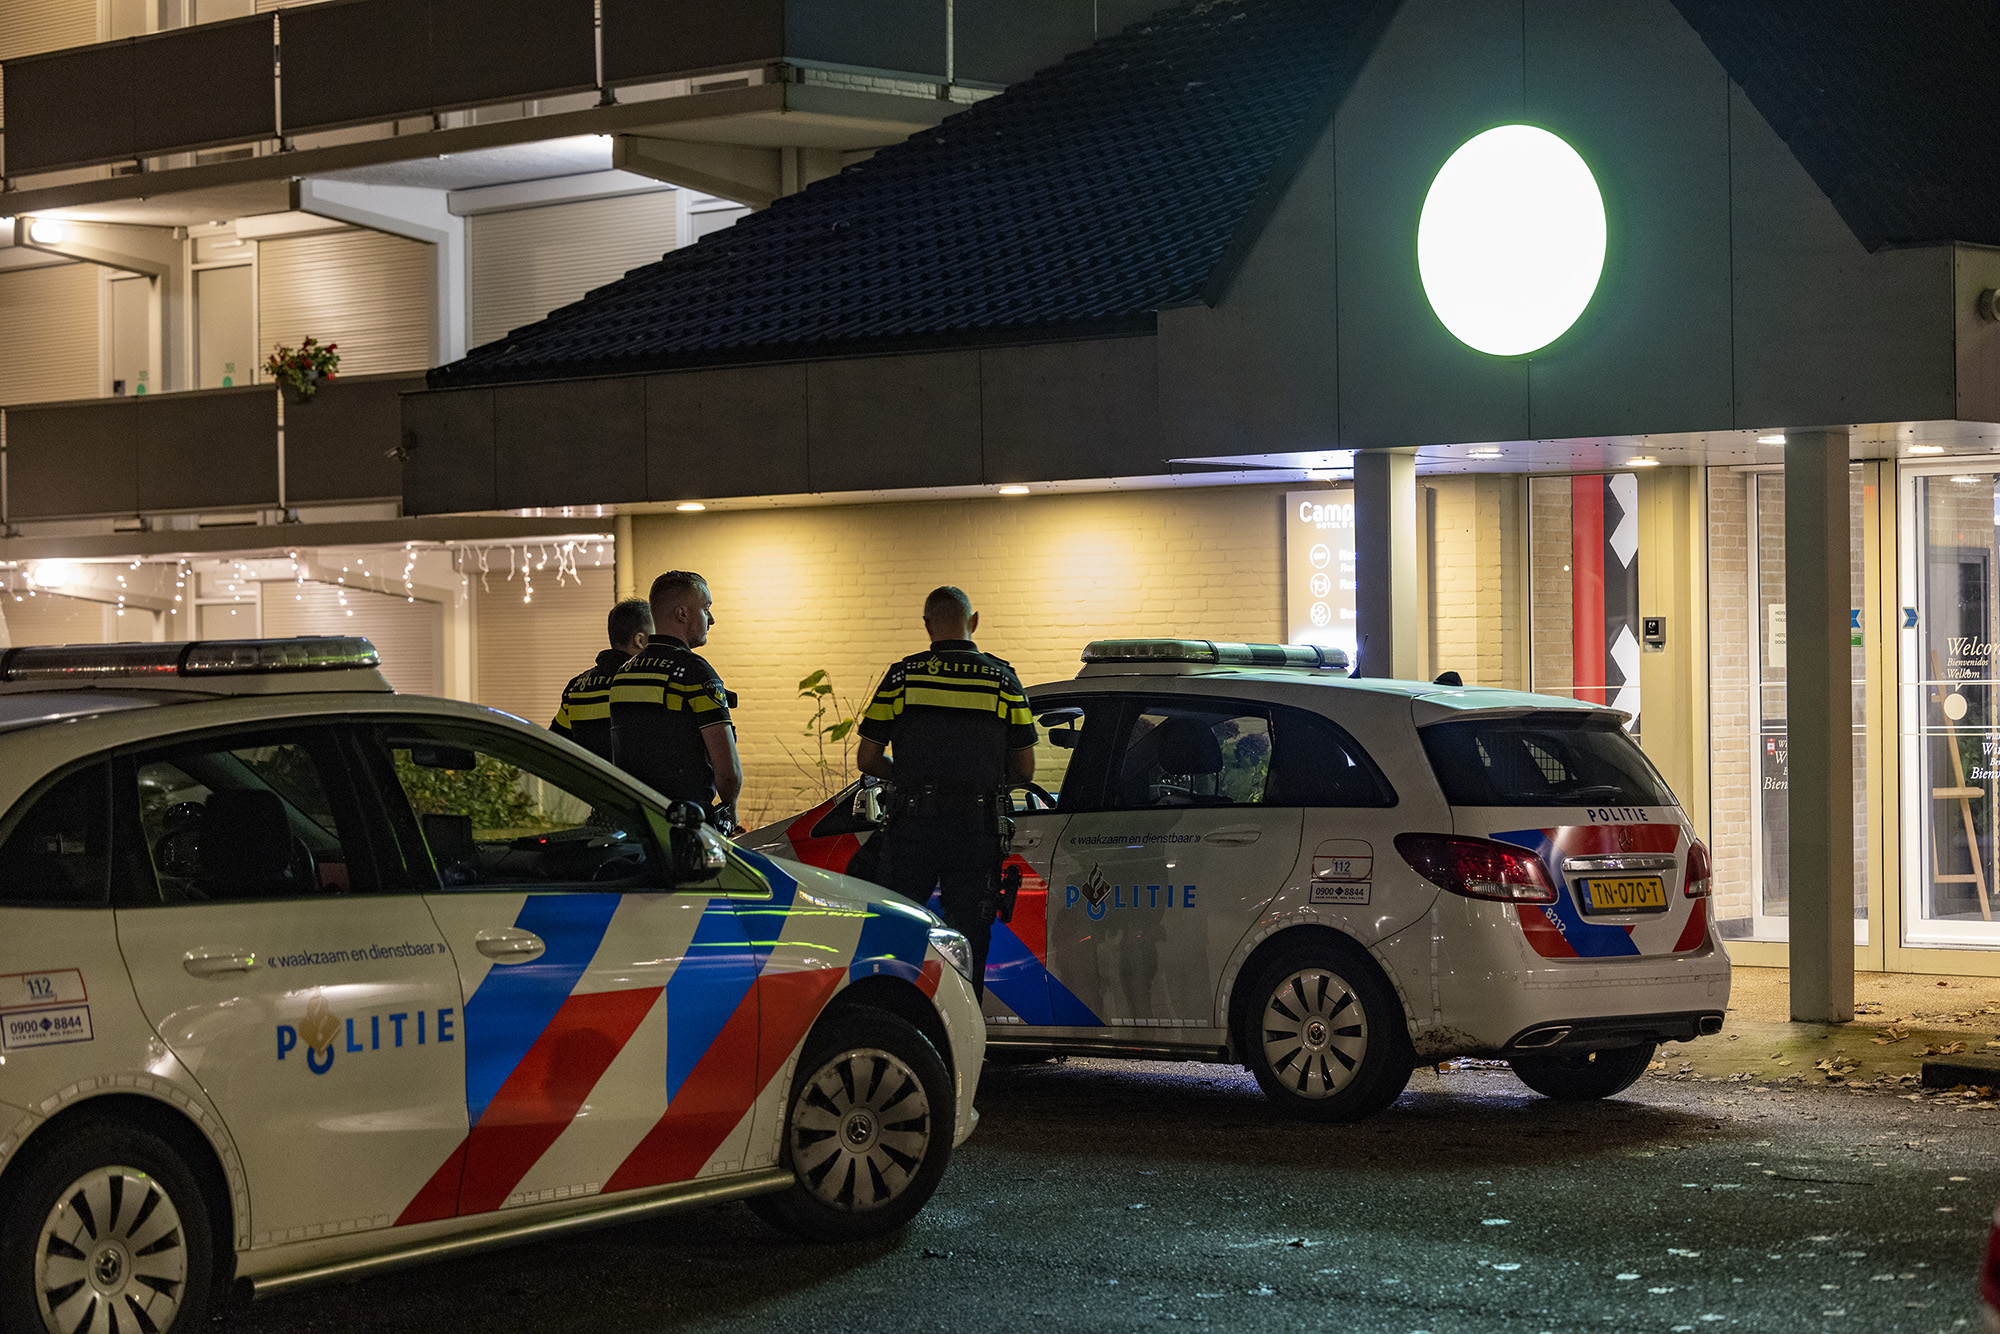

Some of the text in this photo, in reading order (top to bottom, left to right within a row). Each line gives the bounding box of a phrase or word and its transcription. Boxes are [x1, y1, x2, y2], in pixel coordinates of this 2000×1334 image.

[917, 660, 989, 675] POLITIE
[1947, 657, 1989, 666] Bienvenidos
[1947, 668, 1980, 679] Welkom
[1586, 808, 1649, 823] POLITIE
[1078, 834, 1128, 845] waakzaam
[1128, 835, 1141, 844] en
[1142, 832, 1194, 844] dienstbaar
[1334, 861, 1351, 872] 112
[1315, 887, 1364, 896] 0900 8844
[1592, 881, 1659, 905] TN-070-T
[1065, 884, 1197, 921] POLITIE
[1545, 907, 1567, 935] 8212
[278, 949, 351, 968] waakzaam
[351, 949, 369, 962] en
[369, 941, 436, 960] dienstbaar
[27, 977, 53, 995] 112
[10, 1020, 38, 1035] 0900
[53, 1015, 82, 1030] 8844
[276, 1007, 455, 1075] POLITIE
